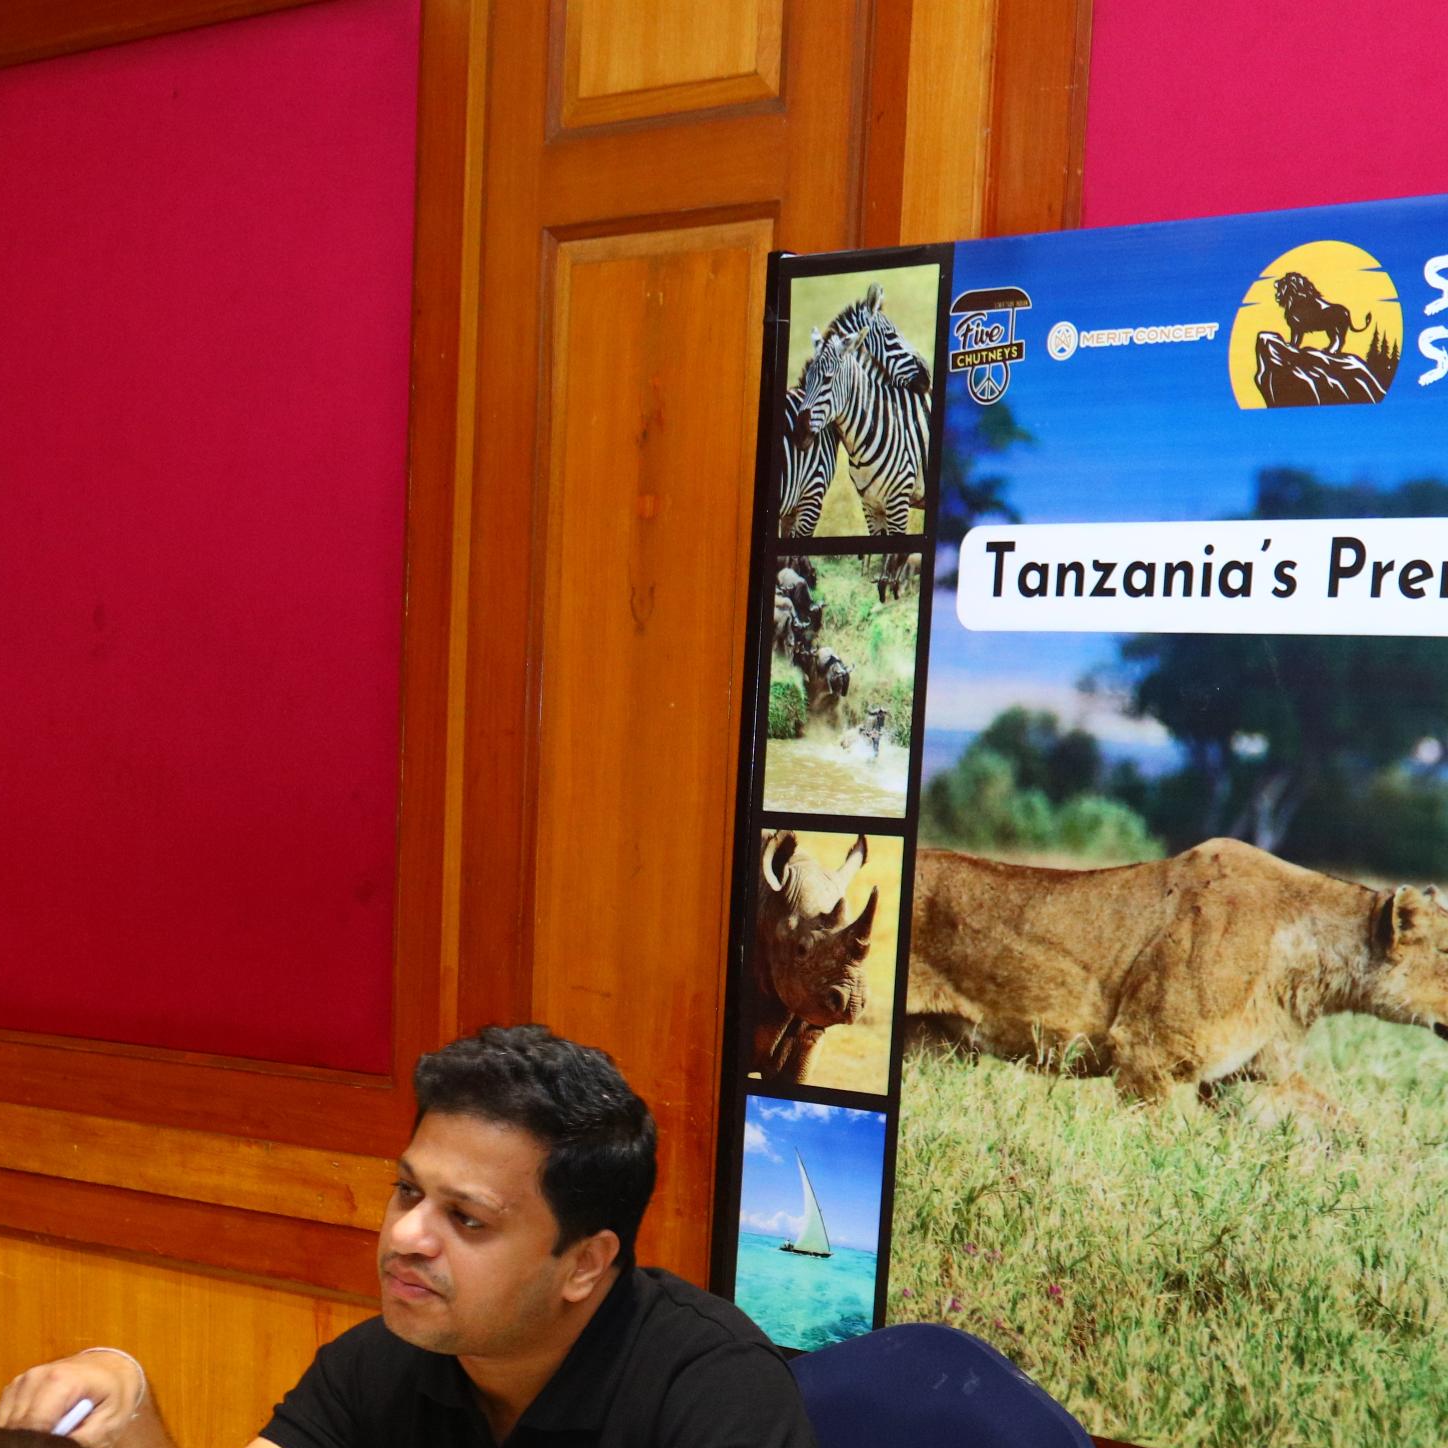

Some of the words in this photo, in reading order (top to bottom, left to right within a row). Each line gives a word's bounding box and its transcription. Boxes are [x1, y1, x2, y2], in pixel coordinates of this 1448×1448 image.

[955, 312, 1005, 351] Five
[1080, 330, 1133, 347] MERIT
[1134, 323, 1219, 343] CONCEPT
[956, 346, 1018, 367] CHUTNEYS
[985, 538, 1299, 601] Tanzania's
